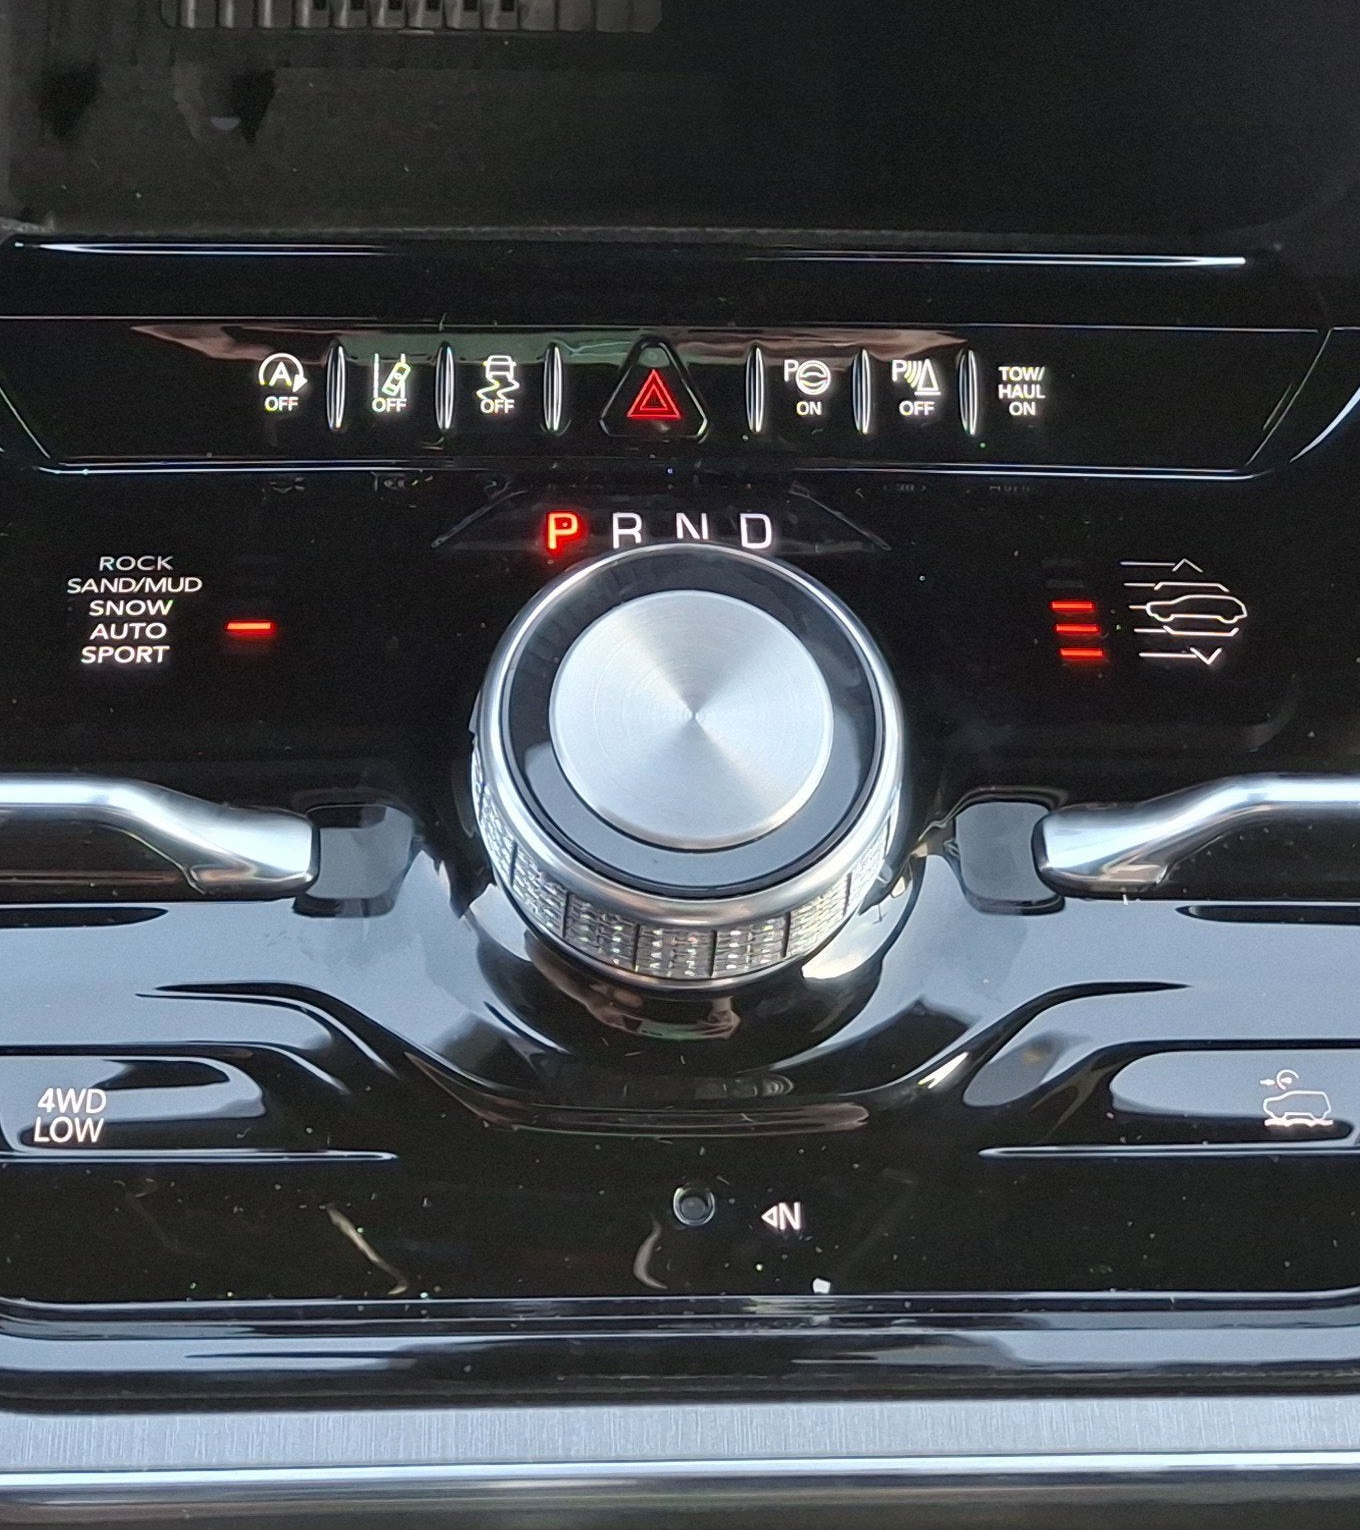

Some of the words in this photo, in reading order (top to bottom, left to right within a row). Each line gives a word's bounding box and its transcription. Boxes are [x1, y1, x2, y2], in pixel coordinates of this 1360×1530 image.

[998, 366, 1045, 383] TOW/
[998, 383, 1046, 400] HAUL
[264, 396, 299, 412] OFF
[371, 398, 407, 413] OFF
[480, 399, 515, 414] OFF
[796, 401, 822, 416] ON
[899, 401, 935, 416] OFF
[1008, 401, 1037, 417] ON
[547, 512, 579, 551] P
[613, 513, 642, 549] R
[676, 513, 709, 540] N
[740, 513, 772, 550] D
[99, 556, 173, 571] ROCK
[67, 576, 203, 594] SAND/MUD
[88, 599, 174, 617] SNOW
[89, 622, 167, 640] AUTO
[81, 645, 170, 664] SPORT
[37, 1087, 107, 1114] 4WD
[33, 1116, 105, 1143] LOW
